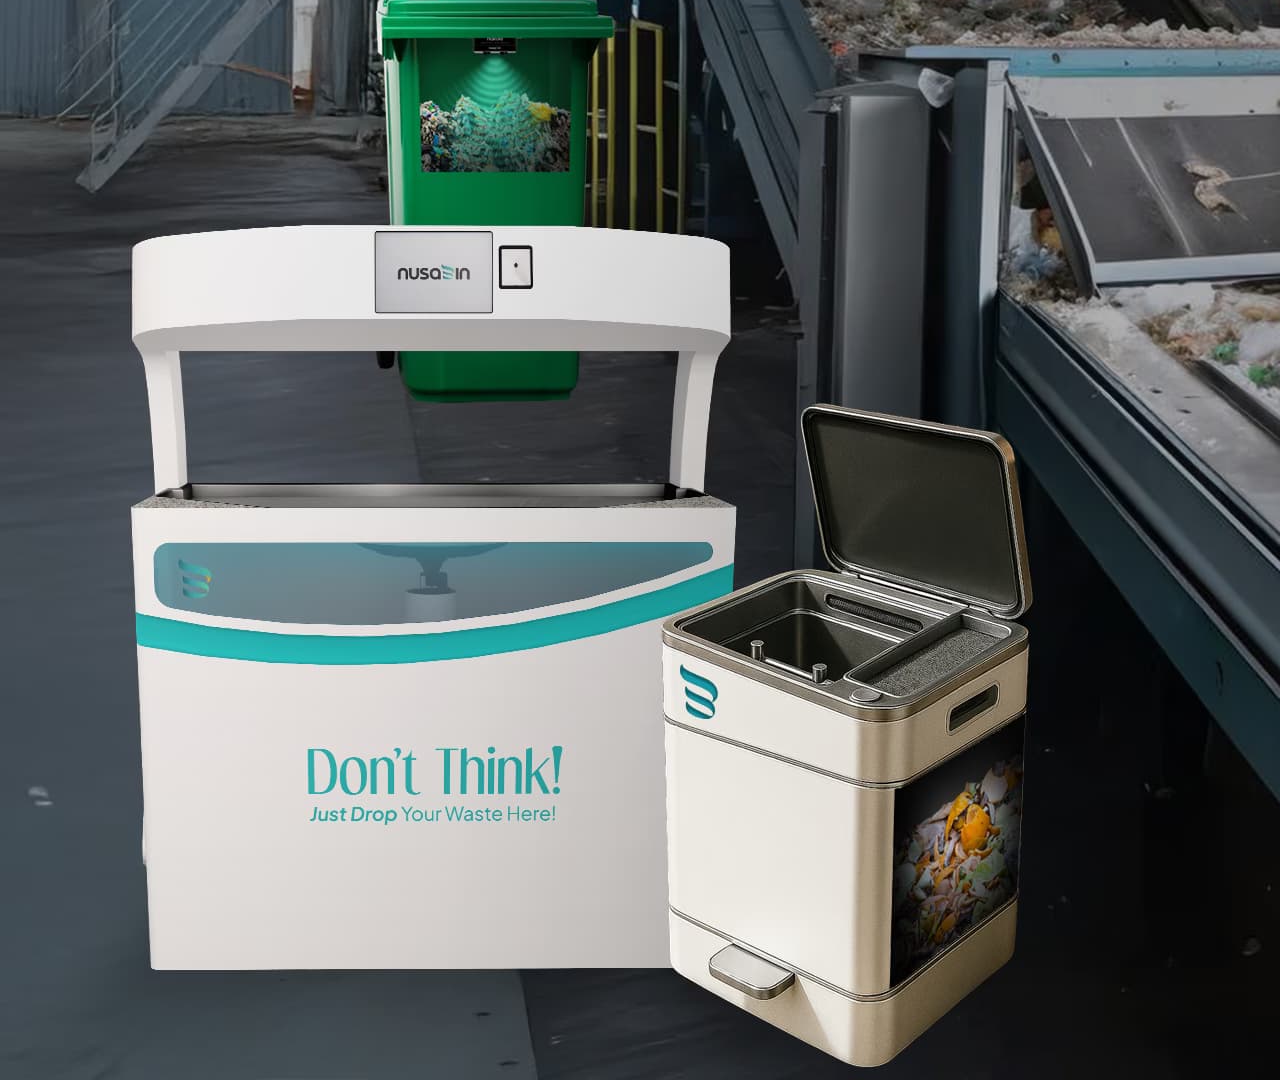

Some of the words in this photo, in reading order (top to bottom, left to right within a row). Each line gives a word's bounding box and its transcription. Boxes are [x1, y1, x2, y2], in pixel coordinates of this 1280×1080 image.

[434, 745, 563, 795] Think!
[309, 806, 348, 822] Just
[350, 806, 398, 826] Drop
[401, 806, 442, 822] Your
[444, 806, 503, 822] Waste
[507, 805, 556, 822] Here!
